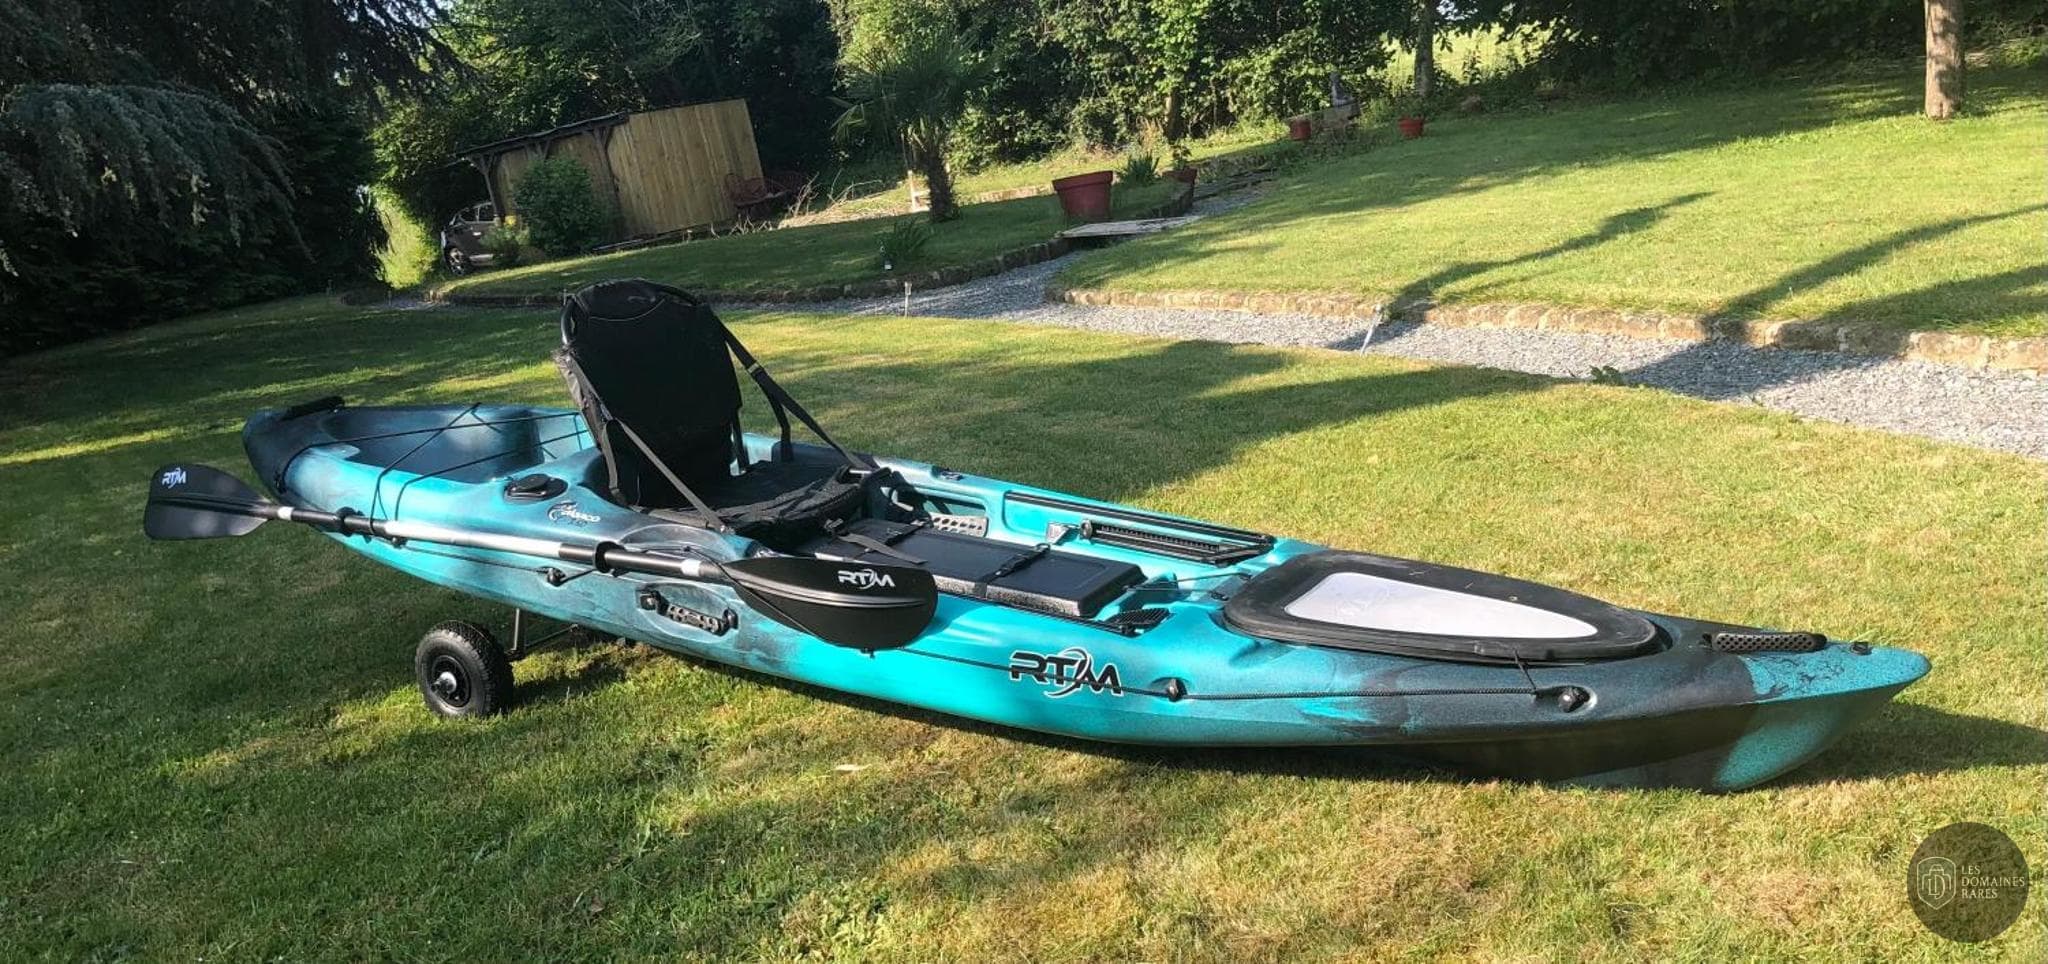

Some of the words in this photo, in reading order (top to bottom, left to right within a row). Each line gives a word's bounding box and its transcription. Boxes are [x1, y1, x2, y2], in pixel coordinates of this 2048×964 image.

[161, 467, 187, 489] RTM
[837, 568, 896, 590] RTM
[1009, 647, 1124, 698] RTM
